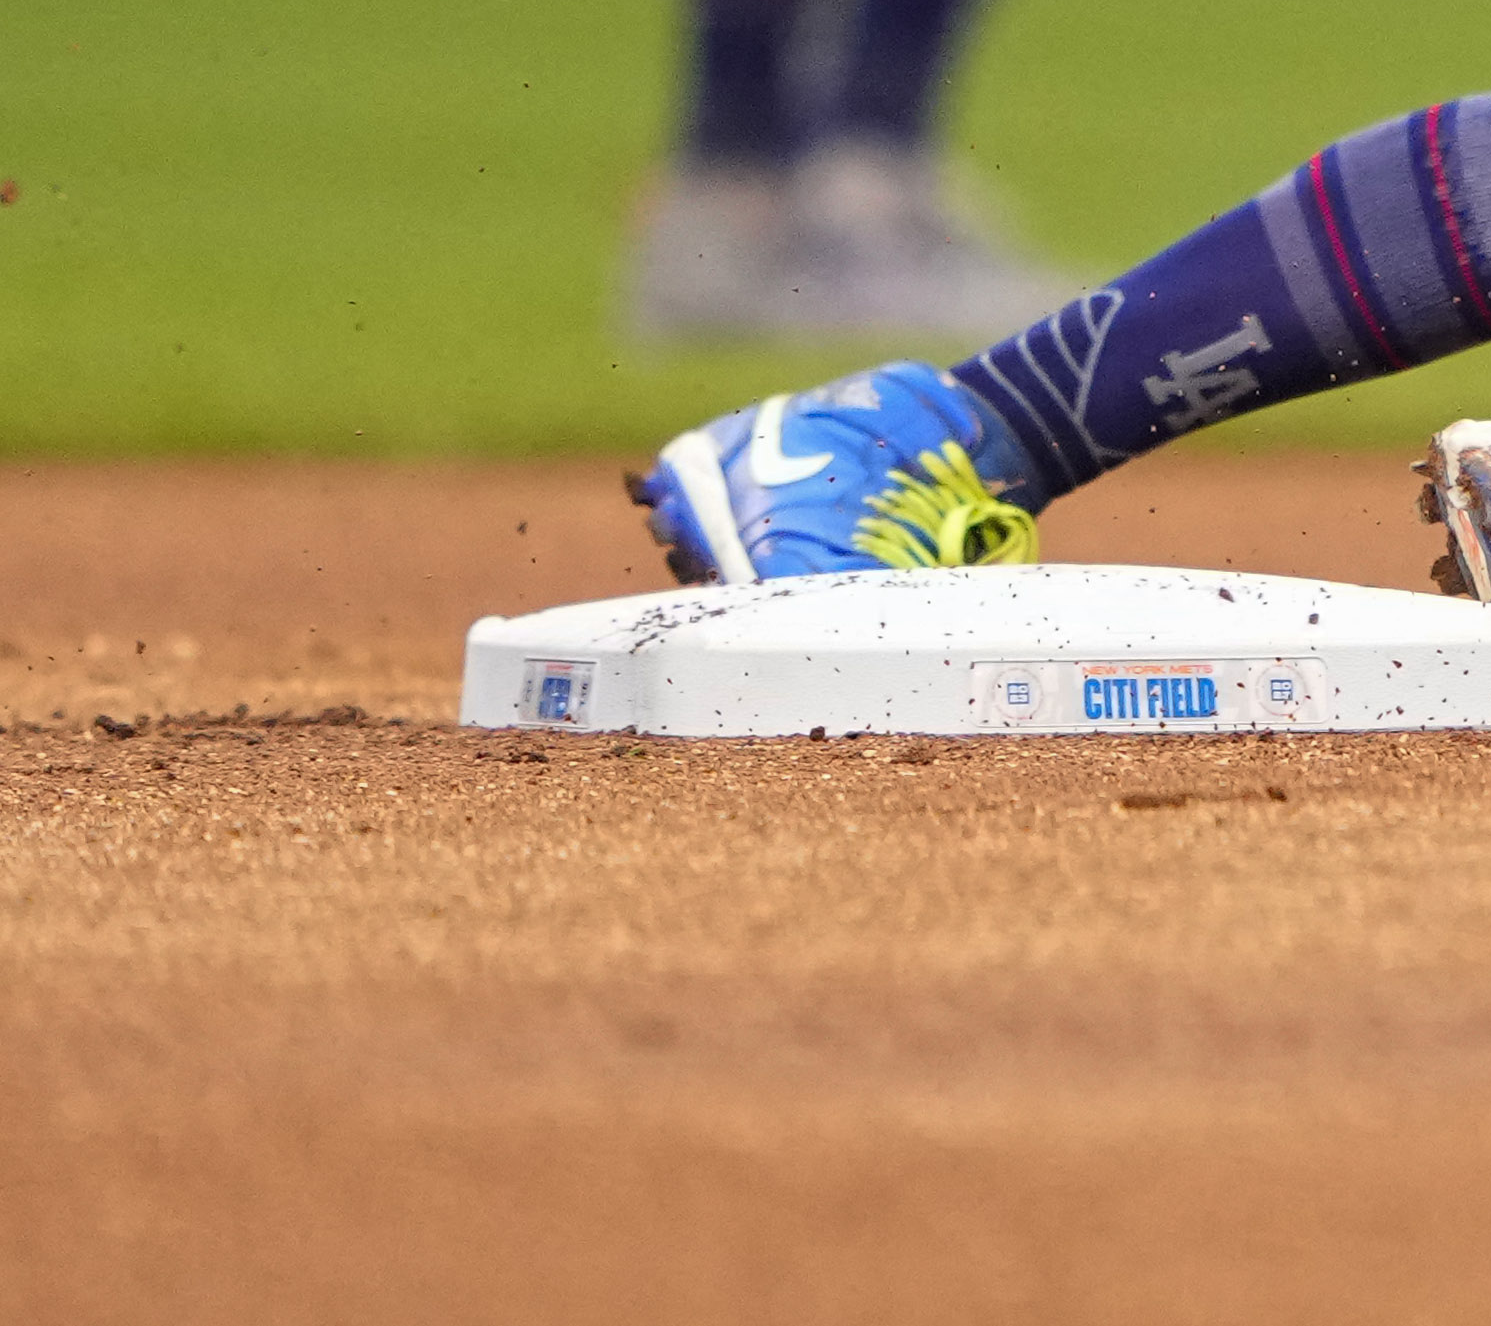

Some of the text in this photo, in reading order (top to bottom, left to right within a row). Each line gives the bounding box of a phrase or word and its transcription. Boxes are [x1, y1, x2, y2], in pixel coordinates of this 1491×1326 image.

[1082, 663, 1213, 675] NEW YORK METS
[1083, 676, 1217, 720] CITI FIELD
